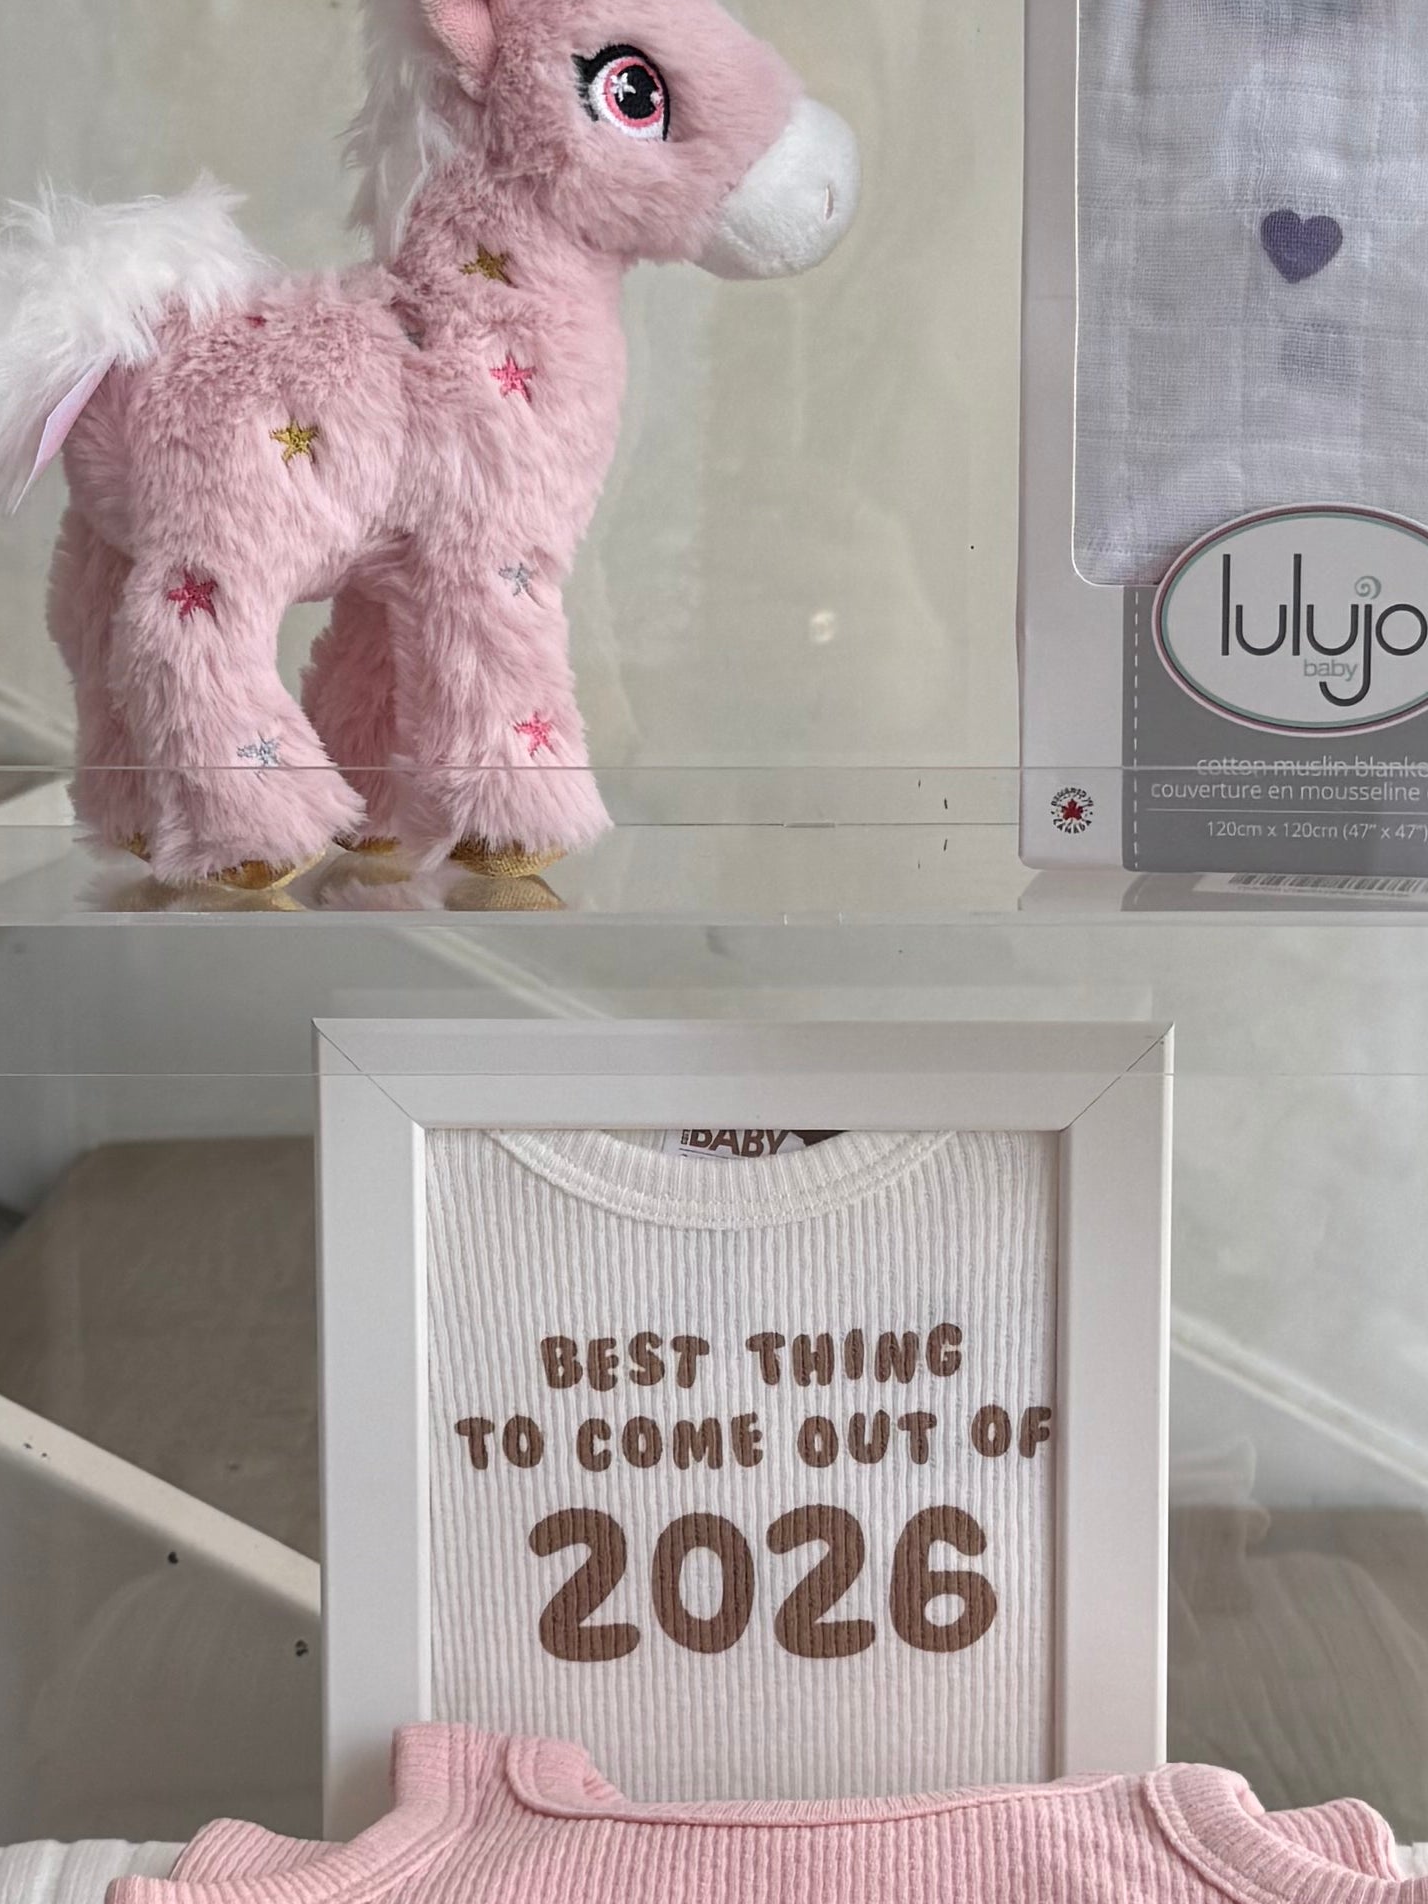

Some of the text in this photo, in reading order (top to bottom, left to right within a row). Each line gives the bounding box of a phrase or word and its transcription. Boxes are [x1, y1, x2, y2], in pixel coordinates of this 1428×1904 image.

[1221, 553, 1428, 707] lulujo
[1303, 659, 1358, 682] baby
[1273, 755, 1348, 778] muslin
[1150, 783, 1262, 799] couverture
[1267, 784, 1294, 800] en
[1300, 782, 1421, 802] mousseline
[1206, 820, 1262, 838] 120cm
[1267, 825, 1277, 838] x
[1282, 821, 1338, 839] 120cm
[1380, 826, 1391, 840] x
[540, 1322, 963, 1391] BEST THING
[454, 1404, 1053, 1472] TO COME OUT OF
[527, 1503, 998, 1663] 2026
